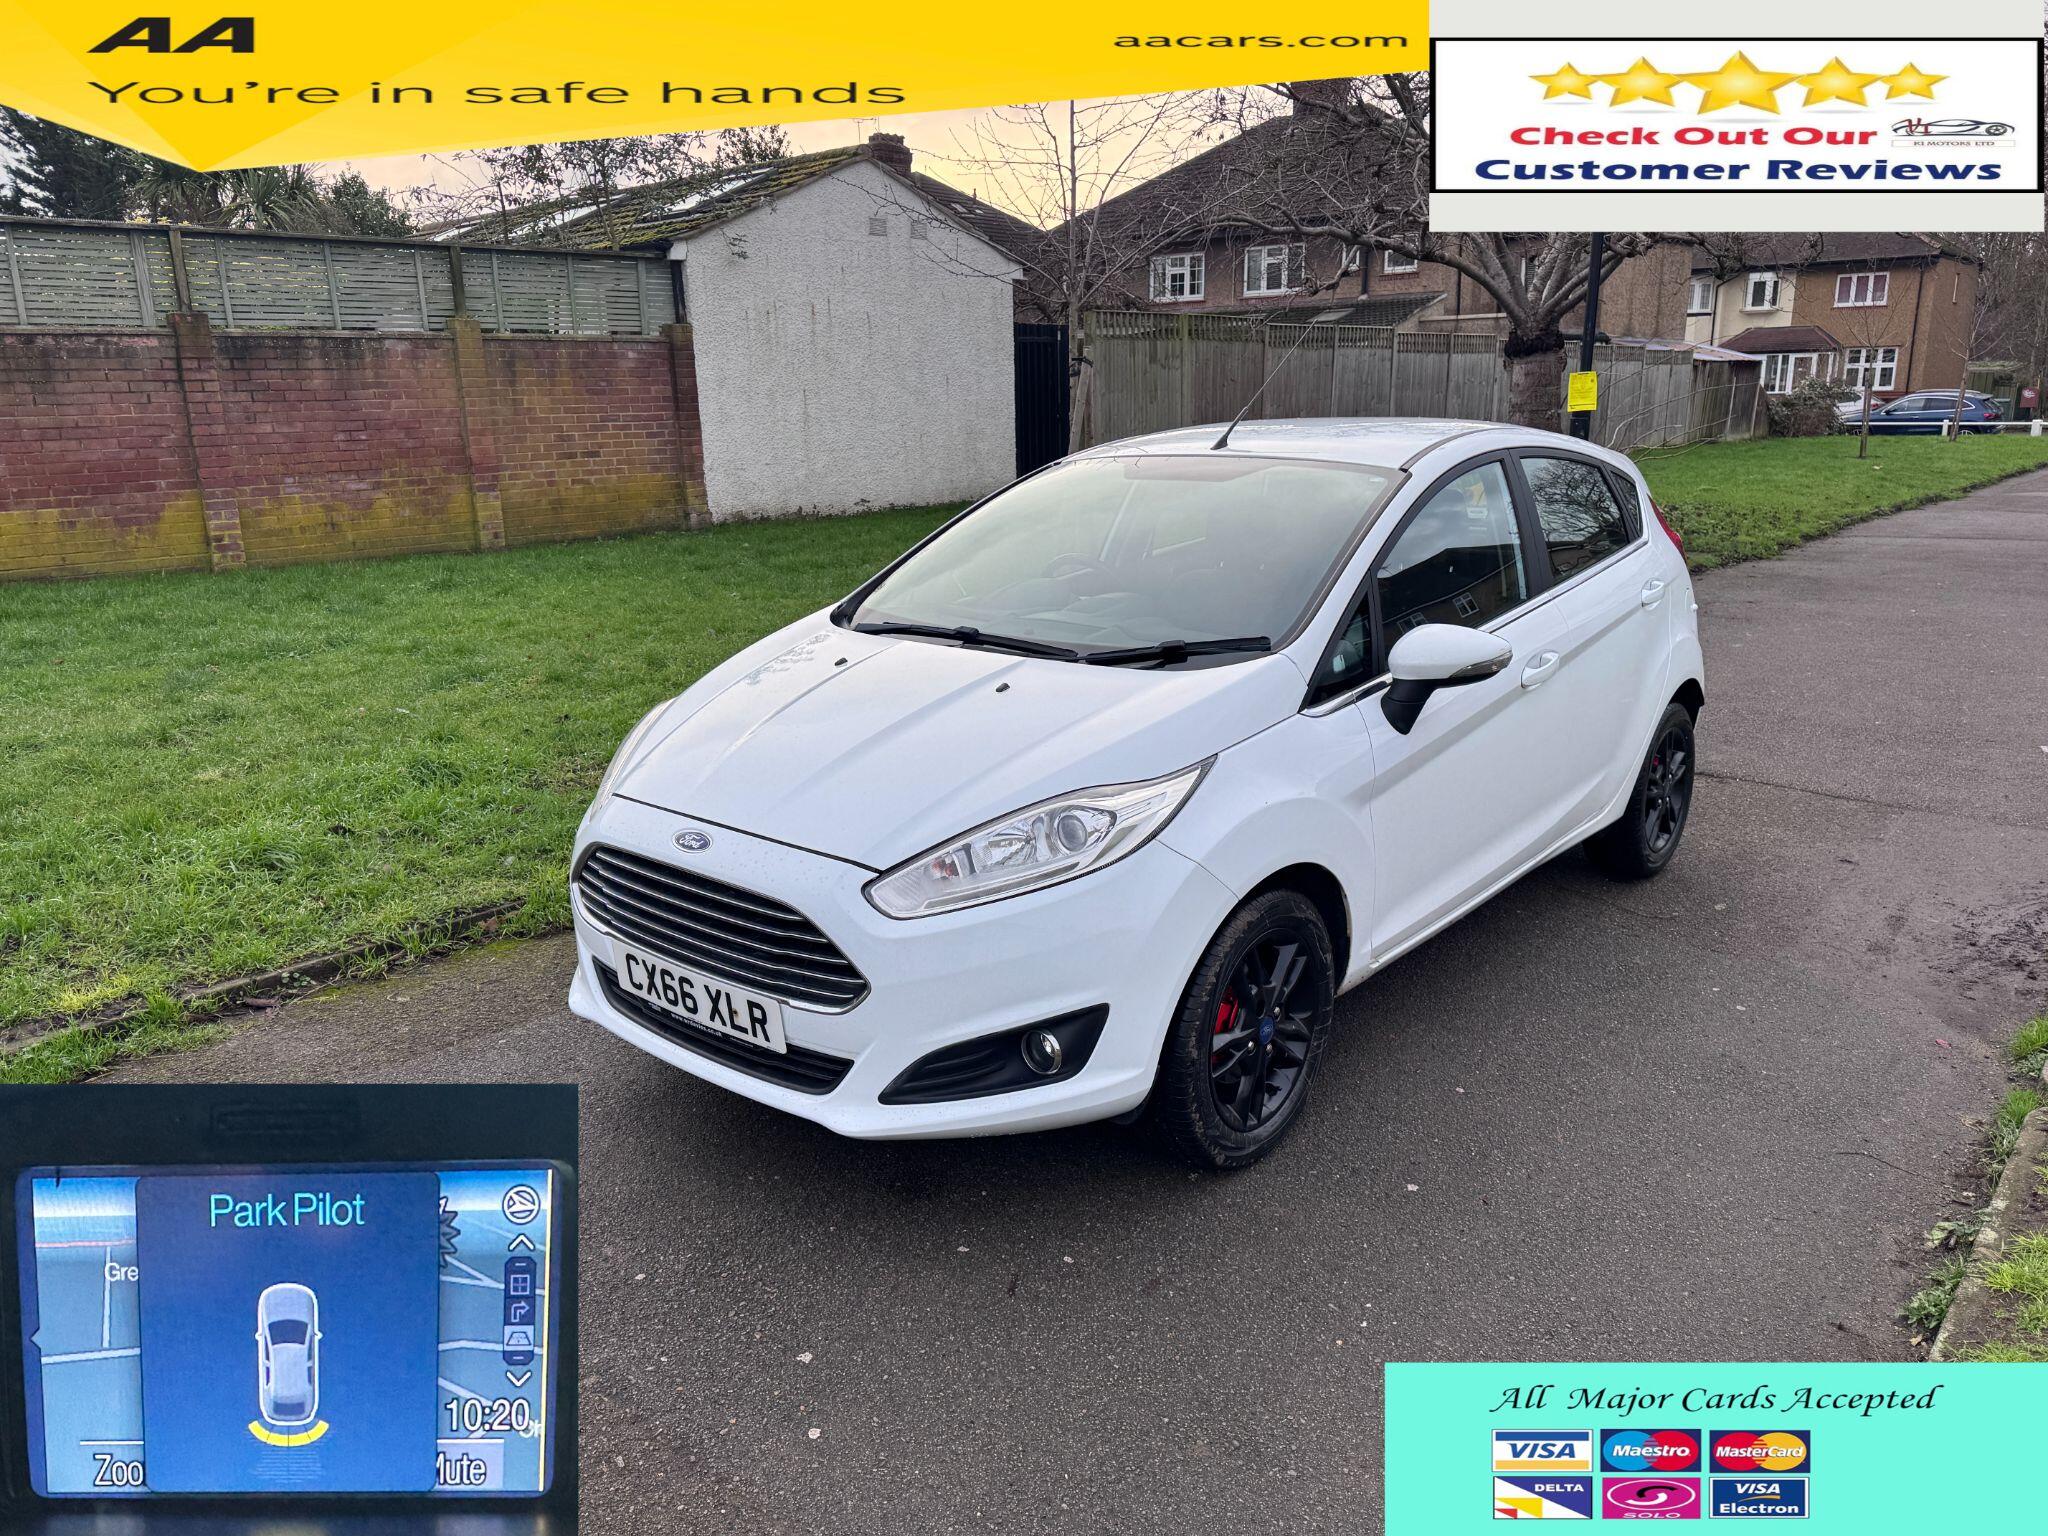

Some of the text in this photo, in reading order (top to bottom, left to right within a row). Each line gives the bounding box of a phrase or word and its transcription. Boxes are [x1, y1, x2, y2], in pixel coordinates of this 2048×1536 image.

[679, 833, 705, 849] Ford
[625, 953, 771, 1043] CX66 XLR
[209, 1191, 366, 1228] Park Pilot
[104, 1262, 139, 1282] Gre
[445, 1398, 530, 1432] 10:20
[93, 1453, 144, 1487] Zoo
